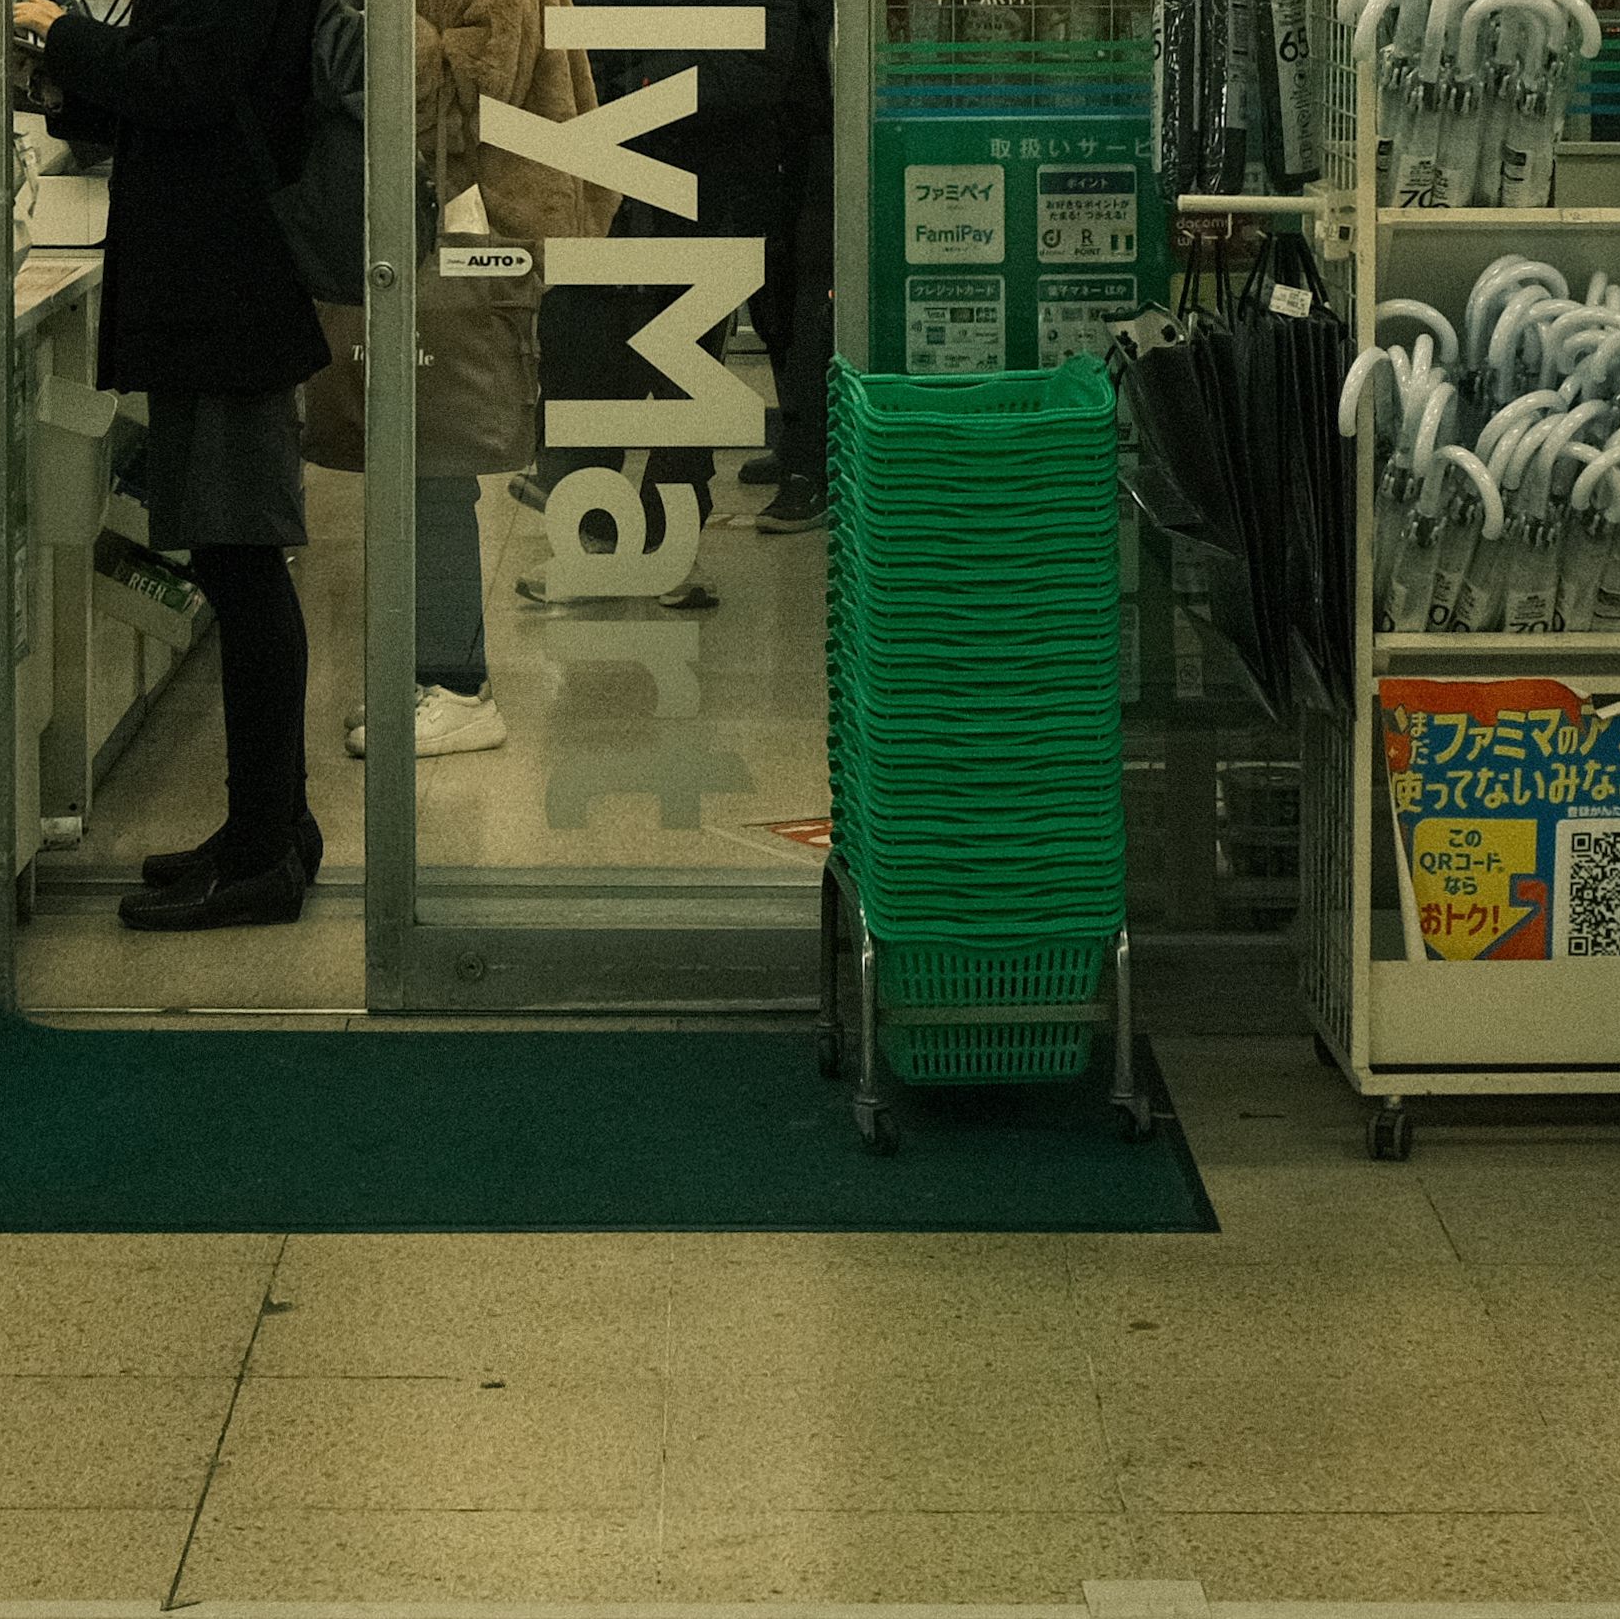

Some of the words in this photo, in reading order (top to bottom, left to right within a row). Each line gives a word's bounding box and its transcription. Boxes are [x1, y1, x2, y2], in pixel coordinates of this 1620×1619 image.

[915, 183, 994, 202] ファミペイ
[915, 225, 994, 244] FamiPay
[467, 255, 515, 268] AUTO
[913, 284, 997, 298] クレジットカード
[1448, 829, 1482, 847] この
[1444, 876, 1479, 896] なら
[1420, 904, 1501, 936] おトク!
